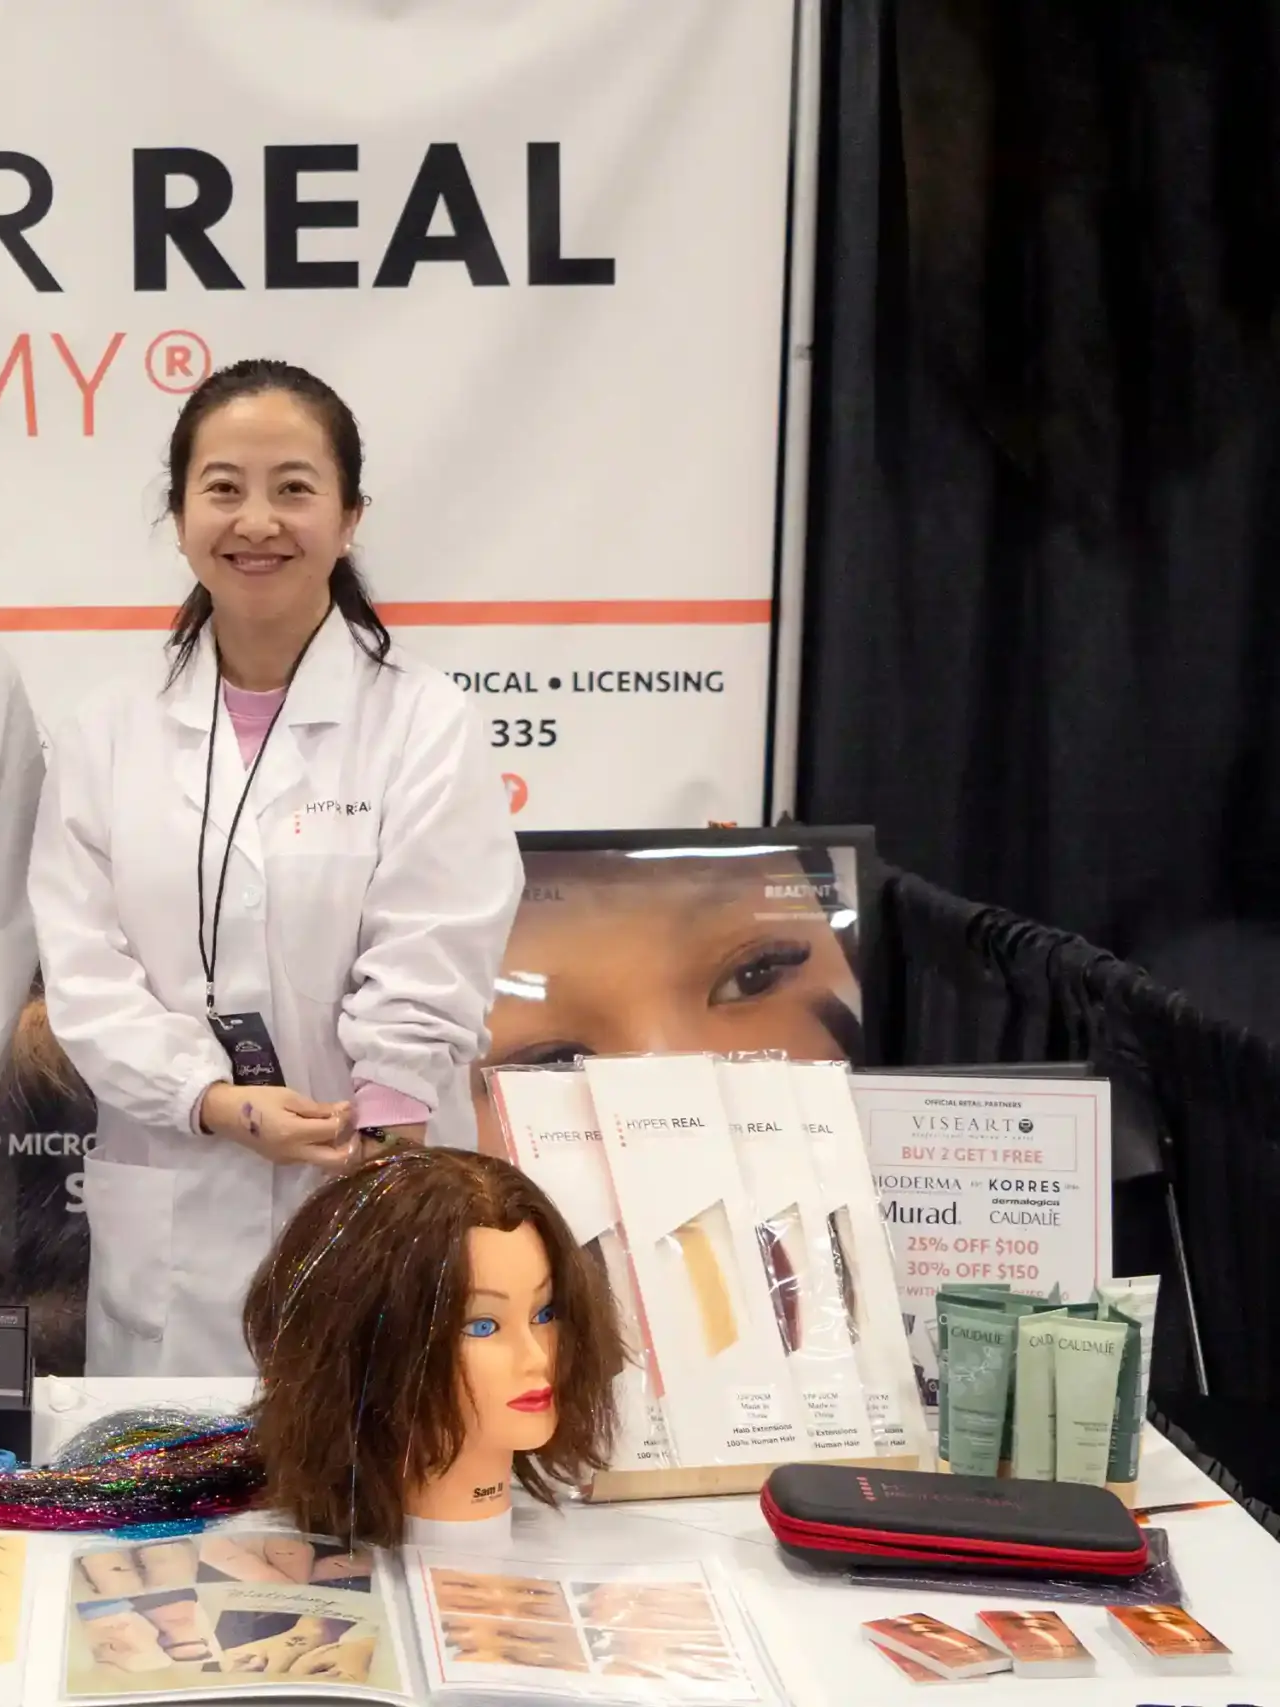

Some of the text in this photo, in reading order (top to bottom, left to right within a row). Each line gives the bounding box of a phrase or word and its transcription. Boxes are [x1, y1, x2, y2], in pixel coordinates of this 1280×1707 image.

[132, 141, 616, 291] REAL
[572, 670, 725, 693] LICENSING
[924, 1099, 957, 1107] OFFICIAL
[626, 1117, 705, 1130] HYPER REAL
[747, 1121, 783, 1134] REAL
[912, 1115, 1015, 1132] VISEART
[540, 1132, 582, 1143] HYPER
[901, 1146, 1044, 1164] BUY 2 GET 1 FREE
[989, 1178, 1061, 1193] KORRES
[991, 1197, 1061, 1207] dermalogica
[907, 1236, 1040, 1255] 25% OFF $100
[906, 1261, 1040, 1280] 30% OFF $150
